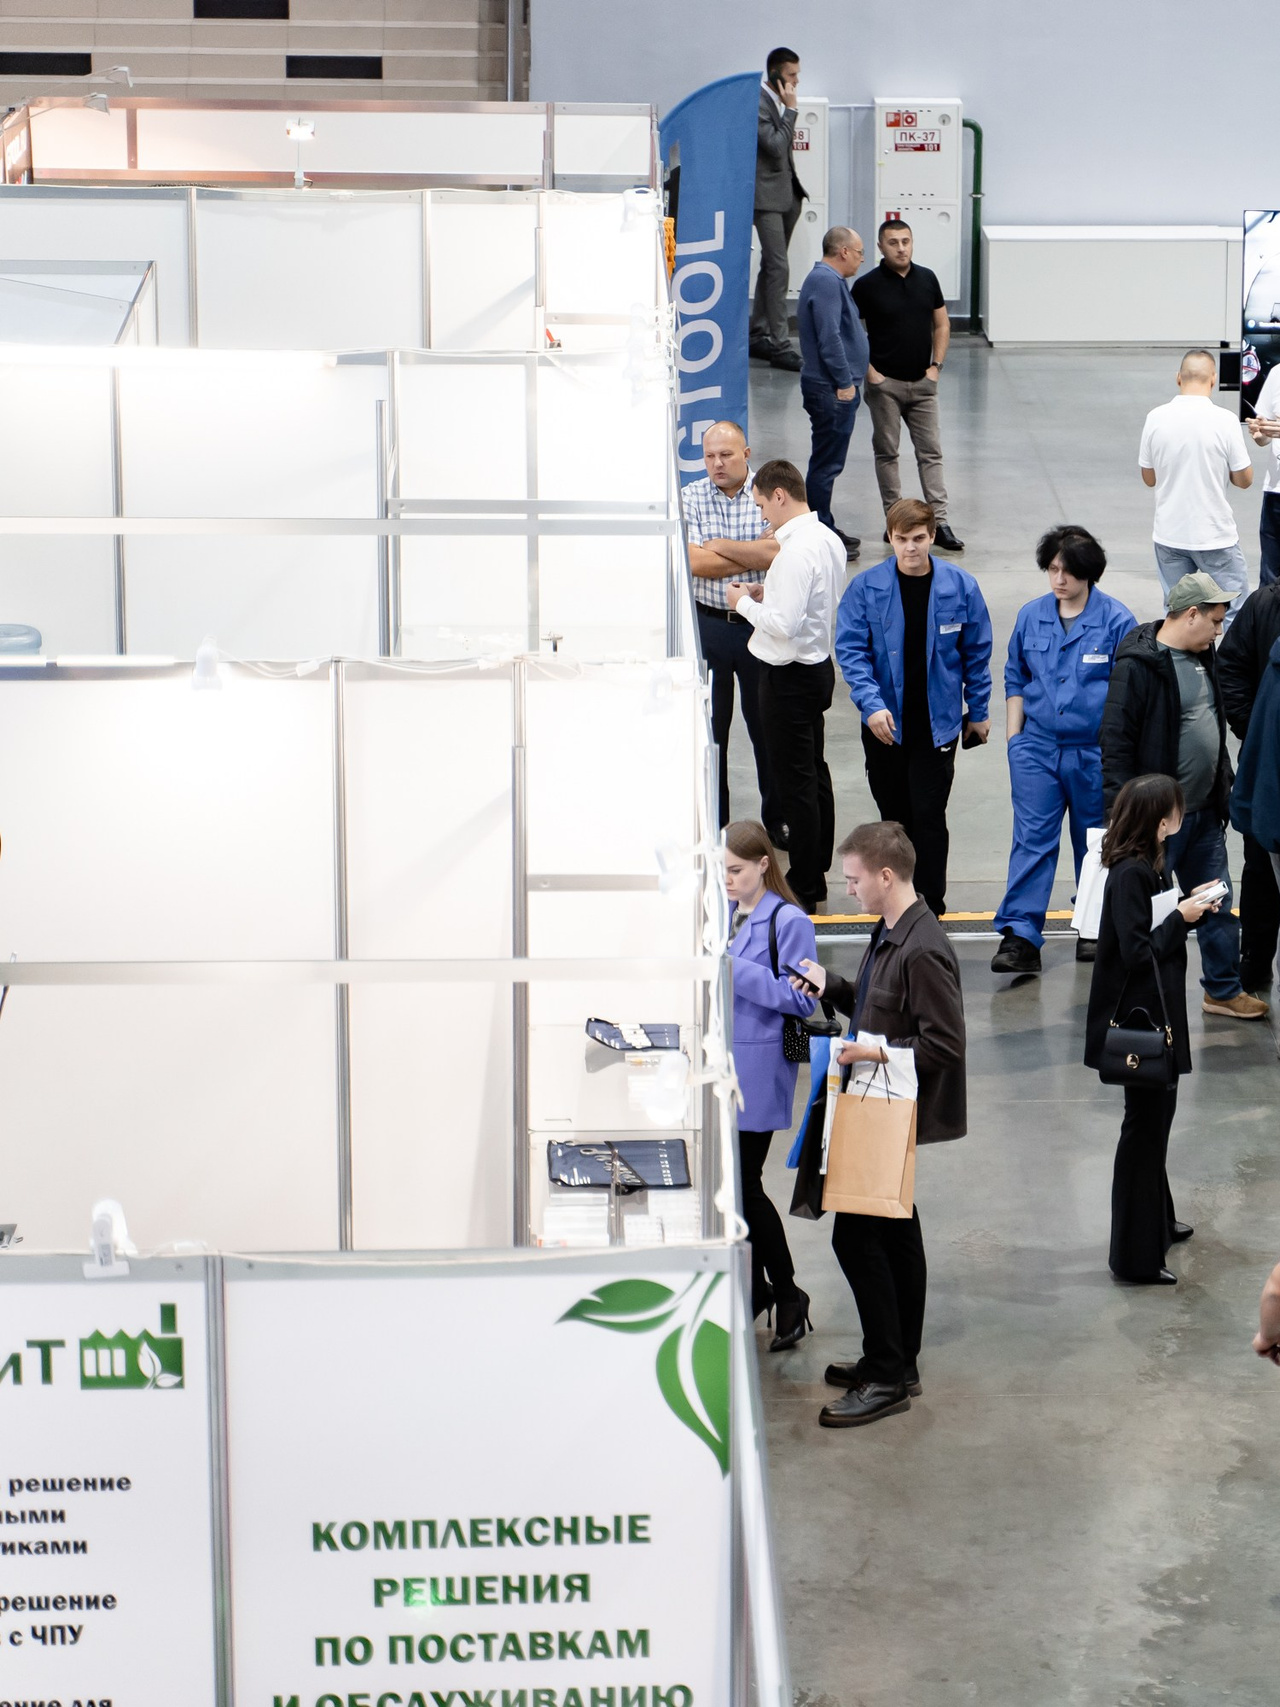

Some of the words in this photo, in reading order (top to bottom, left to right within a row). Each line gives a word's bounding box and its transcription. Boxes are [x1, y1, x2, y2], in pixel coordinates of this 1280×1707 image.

[900, 131, 935, 142] ПК-37
[9, 1476, 132, 1497] решение
[312, 1514, 652, 1552] КОМПЛЕКСНЫЕ
[373, 1574, 592, 1607] РЕШЕНИЯ
[31, 1624, 84, 1646] ЧПУ
[315, 1636, 374, 1667] ПО
[388, 1629, 651, 1665] ПОСТАВКАМ
